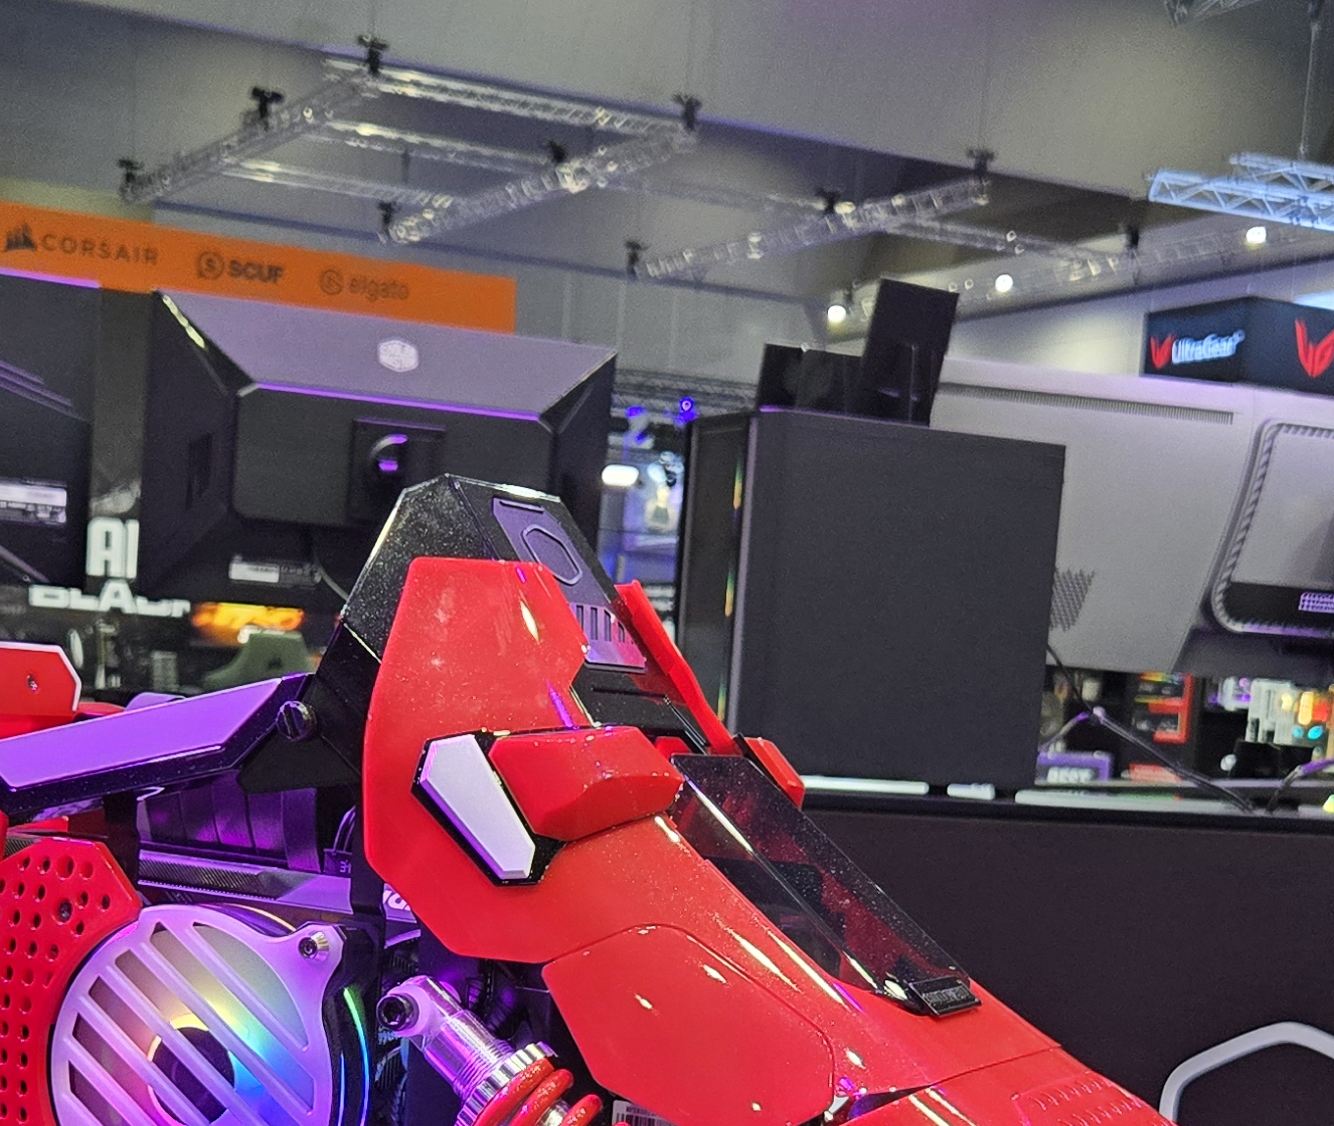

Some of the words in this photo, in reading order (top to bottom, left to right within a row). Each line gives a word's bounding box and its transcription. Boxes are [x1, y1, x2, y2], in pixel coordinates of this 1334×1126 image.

[41, 233, 158, 266] CORSAIR
[227, 259, 284, 284] SCUF
[349, 275, 409, 301] elgato
[86, 517, 140, 579] AI
